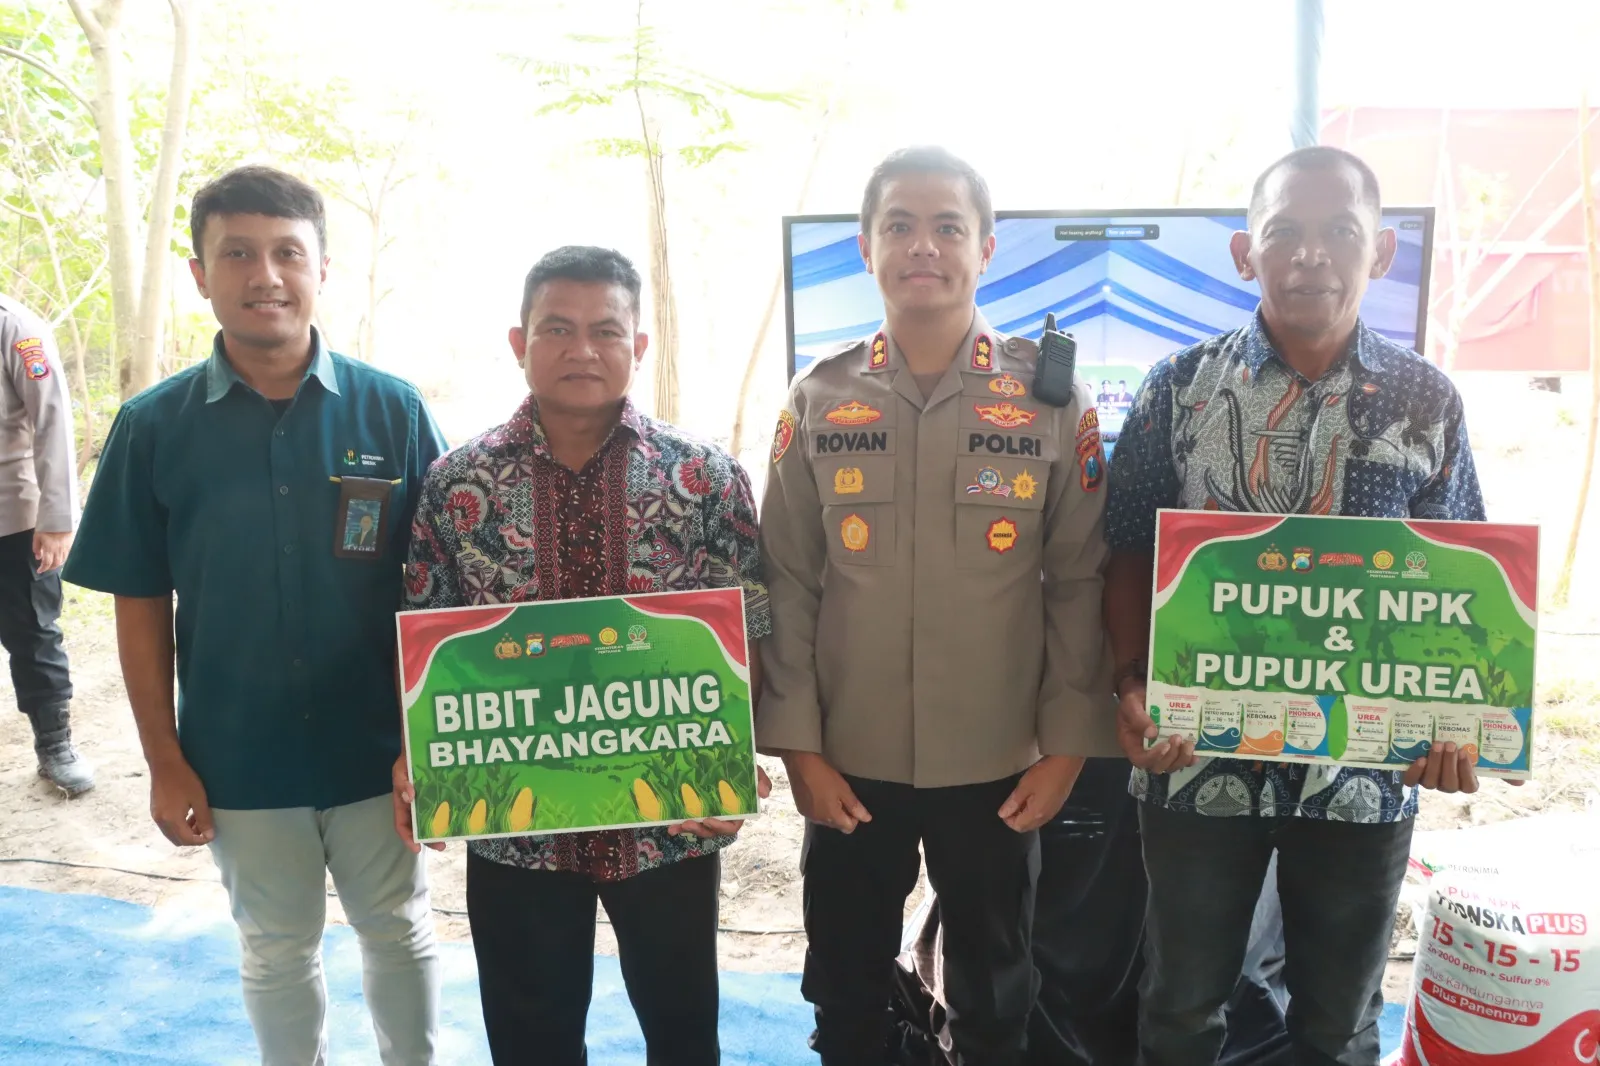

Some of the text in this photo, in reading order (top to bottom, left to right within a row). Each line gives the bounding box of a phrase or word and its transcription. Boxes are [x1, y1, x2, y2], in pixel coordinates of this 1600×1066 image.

[816, 432, 887, 454] ROVAN
[969, 433, 1041, 457] POLRI
[1212, 582, 1473, 625] PUPUK NPK
[1324, 626, 1354, 652] &
[1196, 653, 1484, 700] PUPUK UREA
[434, 674, 721, 733] BIBIT JAGUNG
[429, 720, 732, 768] BHAYANGKARA
[1483, 723, 1518, 731] PHONSKA
[1432, 915, 1454, 946] 15
[1484, 940, 1518, 968] 15
[1550, 948, 1581, 973] 15
[1529, 914, 1586, 934] PLUS
[1424, 964, 1544, 1010] Plus Kandungannya
[1462, 962, 1487, 976] ppm
[1498, 972, 1532, 985] Sulfur
[1534, 977, 1551, 987] 9%
[1432, 984, 1528, 1024] Plus Panennya
